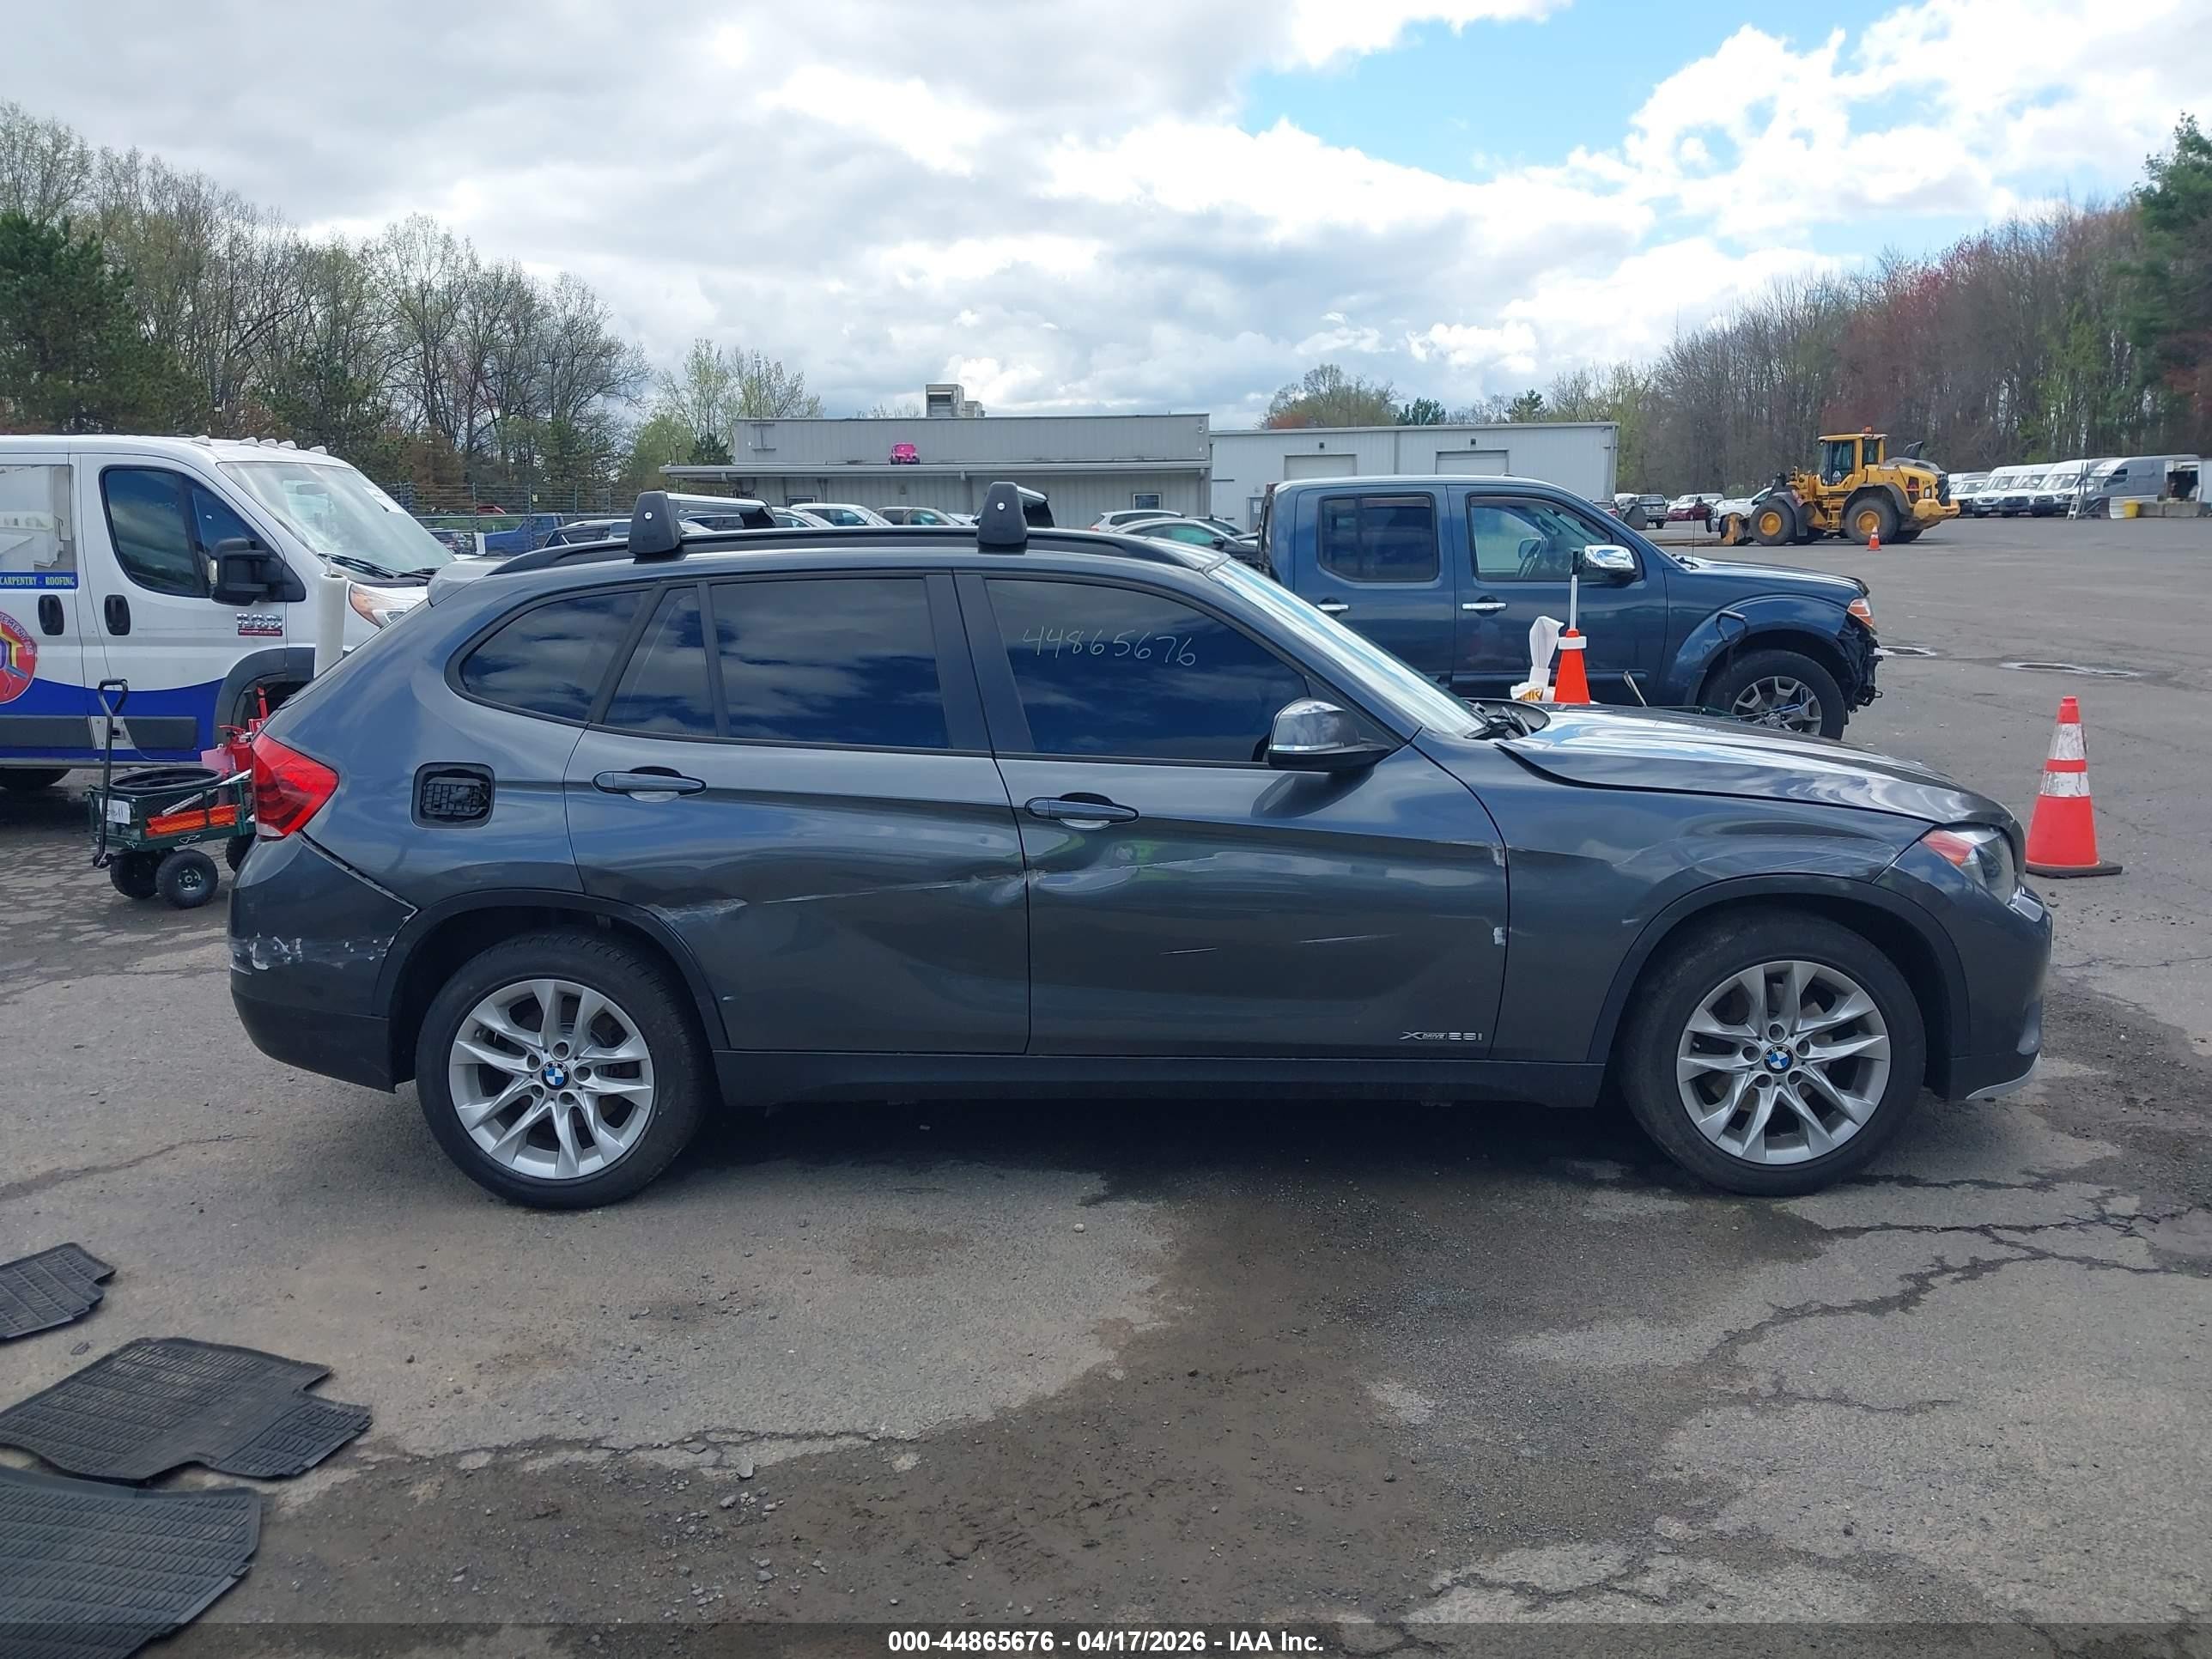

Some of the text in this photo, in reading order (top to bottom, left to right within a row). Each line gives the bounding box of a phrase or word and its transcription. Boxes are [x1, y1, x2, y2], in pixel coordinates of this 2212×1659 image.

[0, 576, 37, 586] CARPENTRY
[46, 576, 75, 586] ROOFING
[1022, 625, 1197, 666] 44865676
